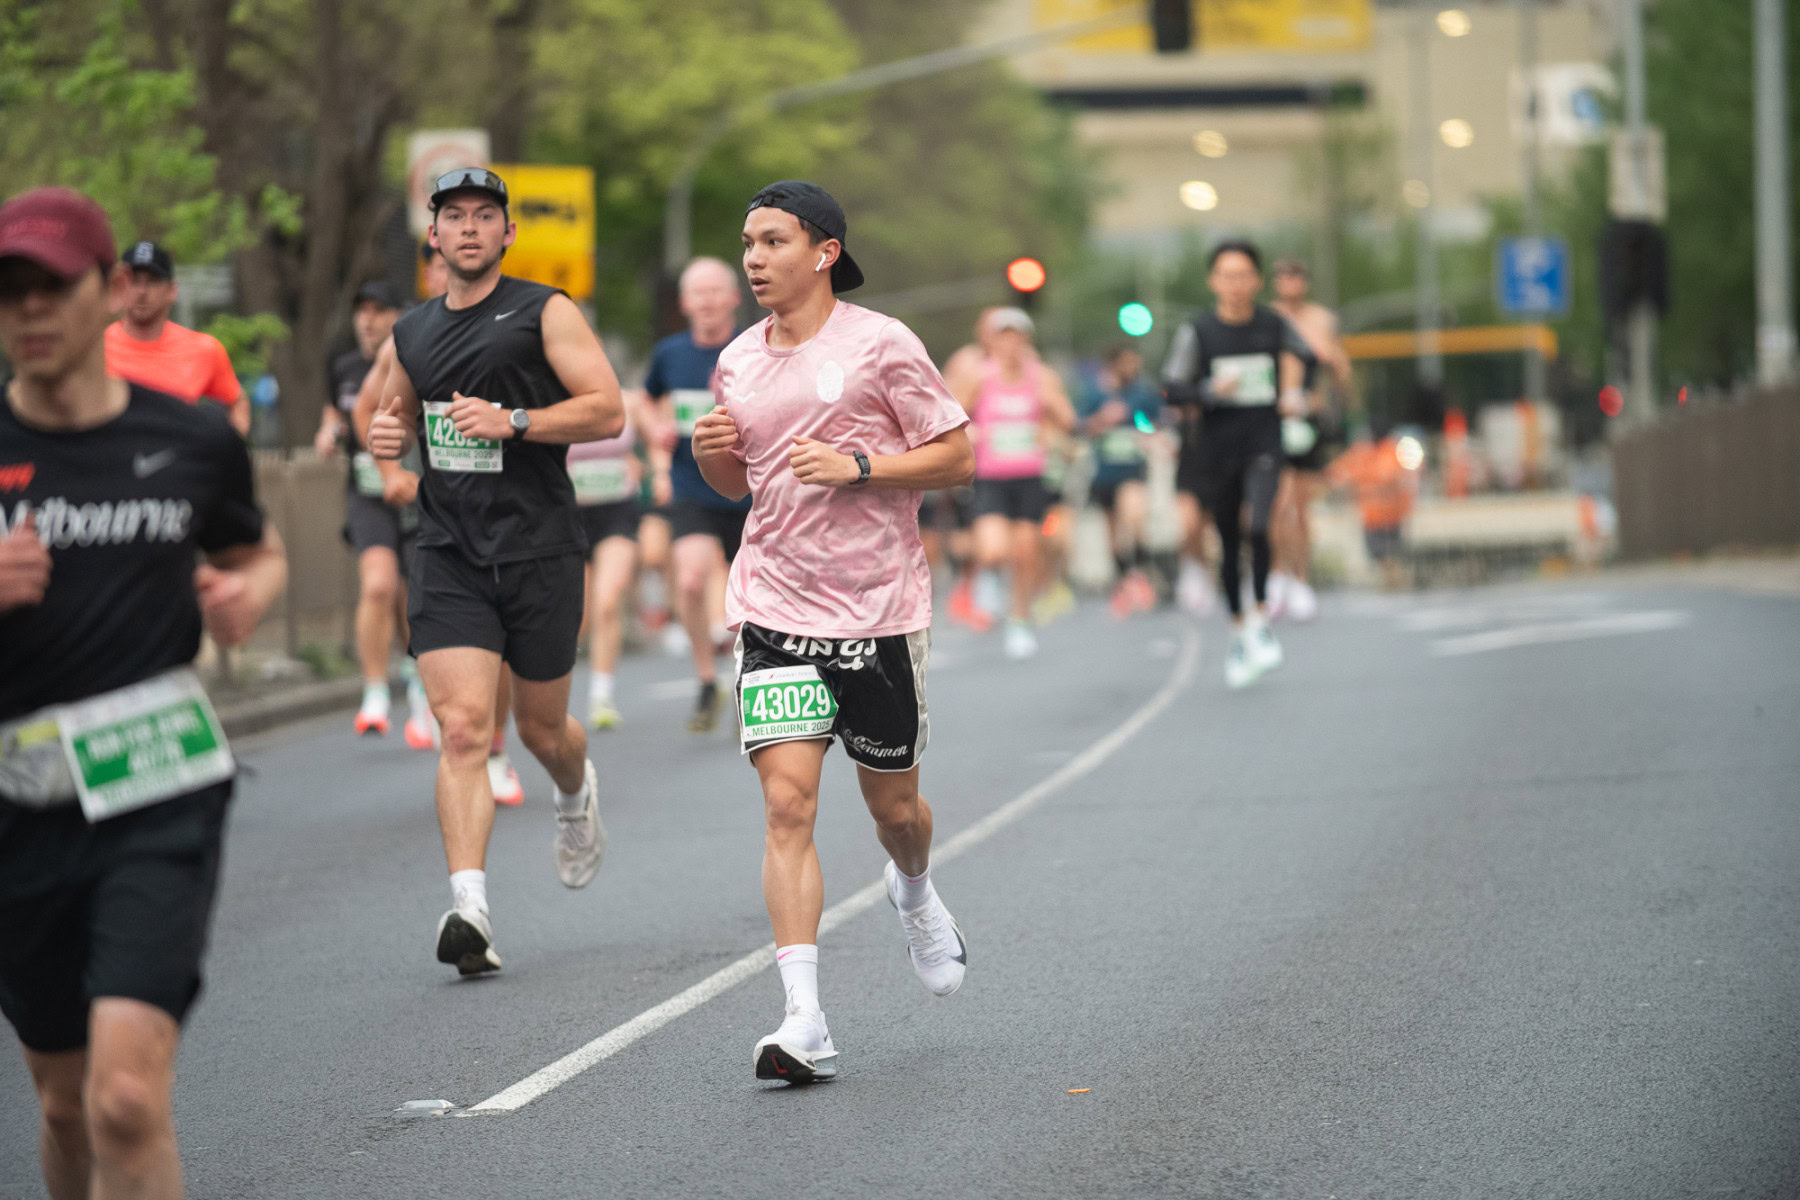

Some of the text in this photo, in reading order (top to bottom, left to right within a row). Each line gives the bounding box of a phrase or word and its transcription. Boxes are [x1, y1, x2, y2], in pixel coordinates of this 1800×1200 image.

[752, 683, 831, 721] 43029
[752, 720, 830, 737] MELBOURNE 2025
